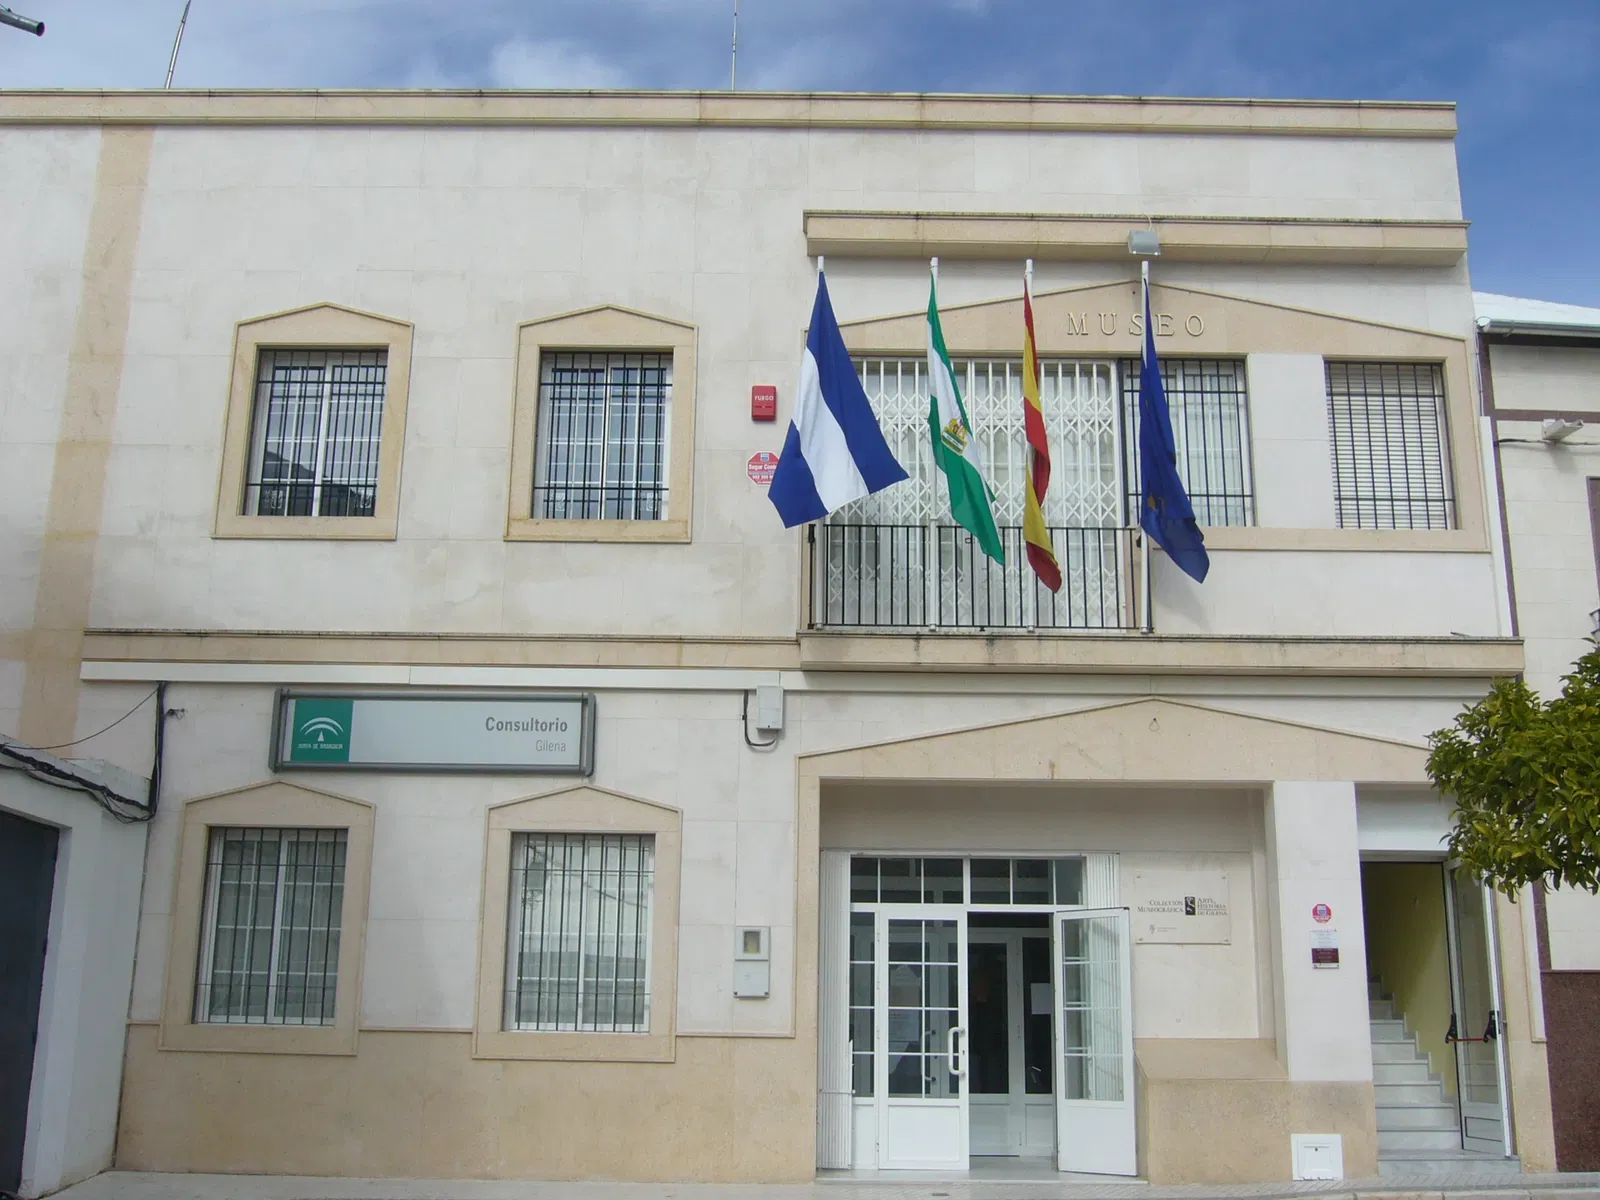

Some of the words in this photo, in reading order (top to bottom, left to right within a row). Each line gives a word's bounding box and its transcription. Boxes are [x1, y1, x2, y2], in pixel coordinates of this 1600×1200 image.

[1067, 312, 1205, 337] MUSEO
[485, 716, 569, 732] Consultorio
[535, 739, 567, 752] Gilena
